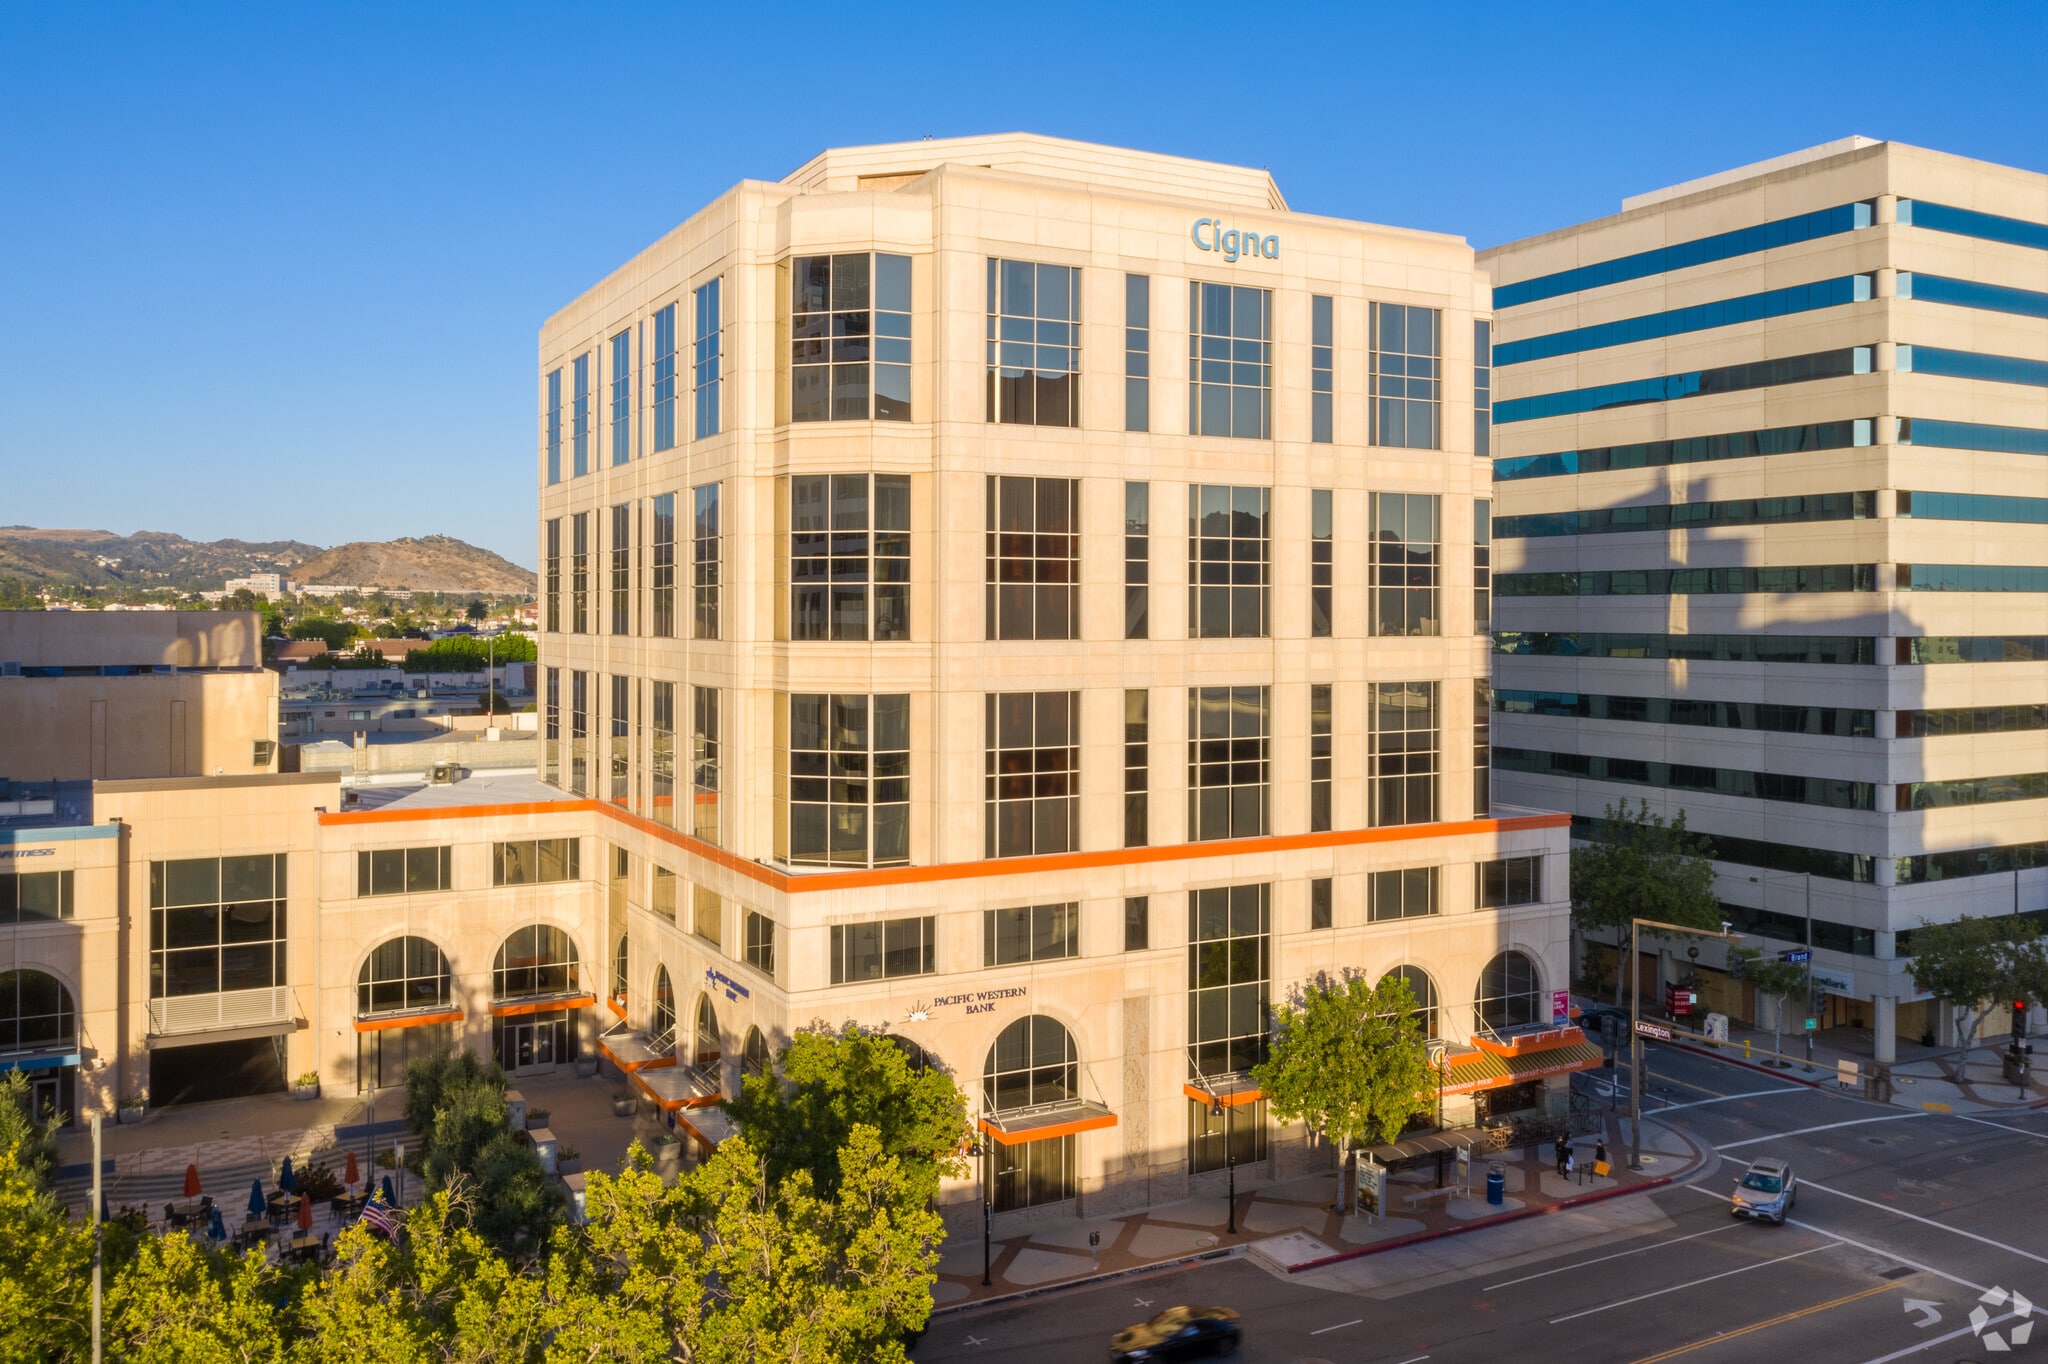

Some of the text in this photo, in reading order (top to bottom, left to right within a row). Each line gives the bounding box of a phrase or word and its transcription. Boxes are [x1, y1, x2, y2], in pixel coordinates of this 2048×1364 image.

[1191, 217, 1280, 263] Cigna
[1790, 953, 1808, 962] Brand
[934, 987, 1027, 1007] PACIFIC WESTERN
[966, 1002, 995, 1015] BANK
[1635, 1021, 1670, 1039] Lexington
[1509, 1060, 1583, 1080] BREAKFAST LUNCH DINNER
[1477, 1078, 1493, 1086] FOOD
